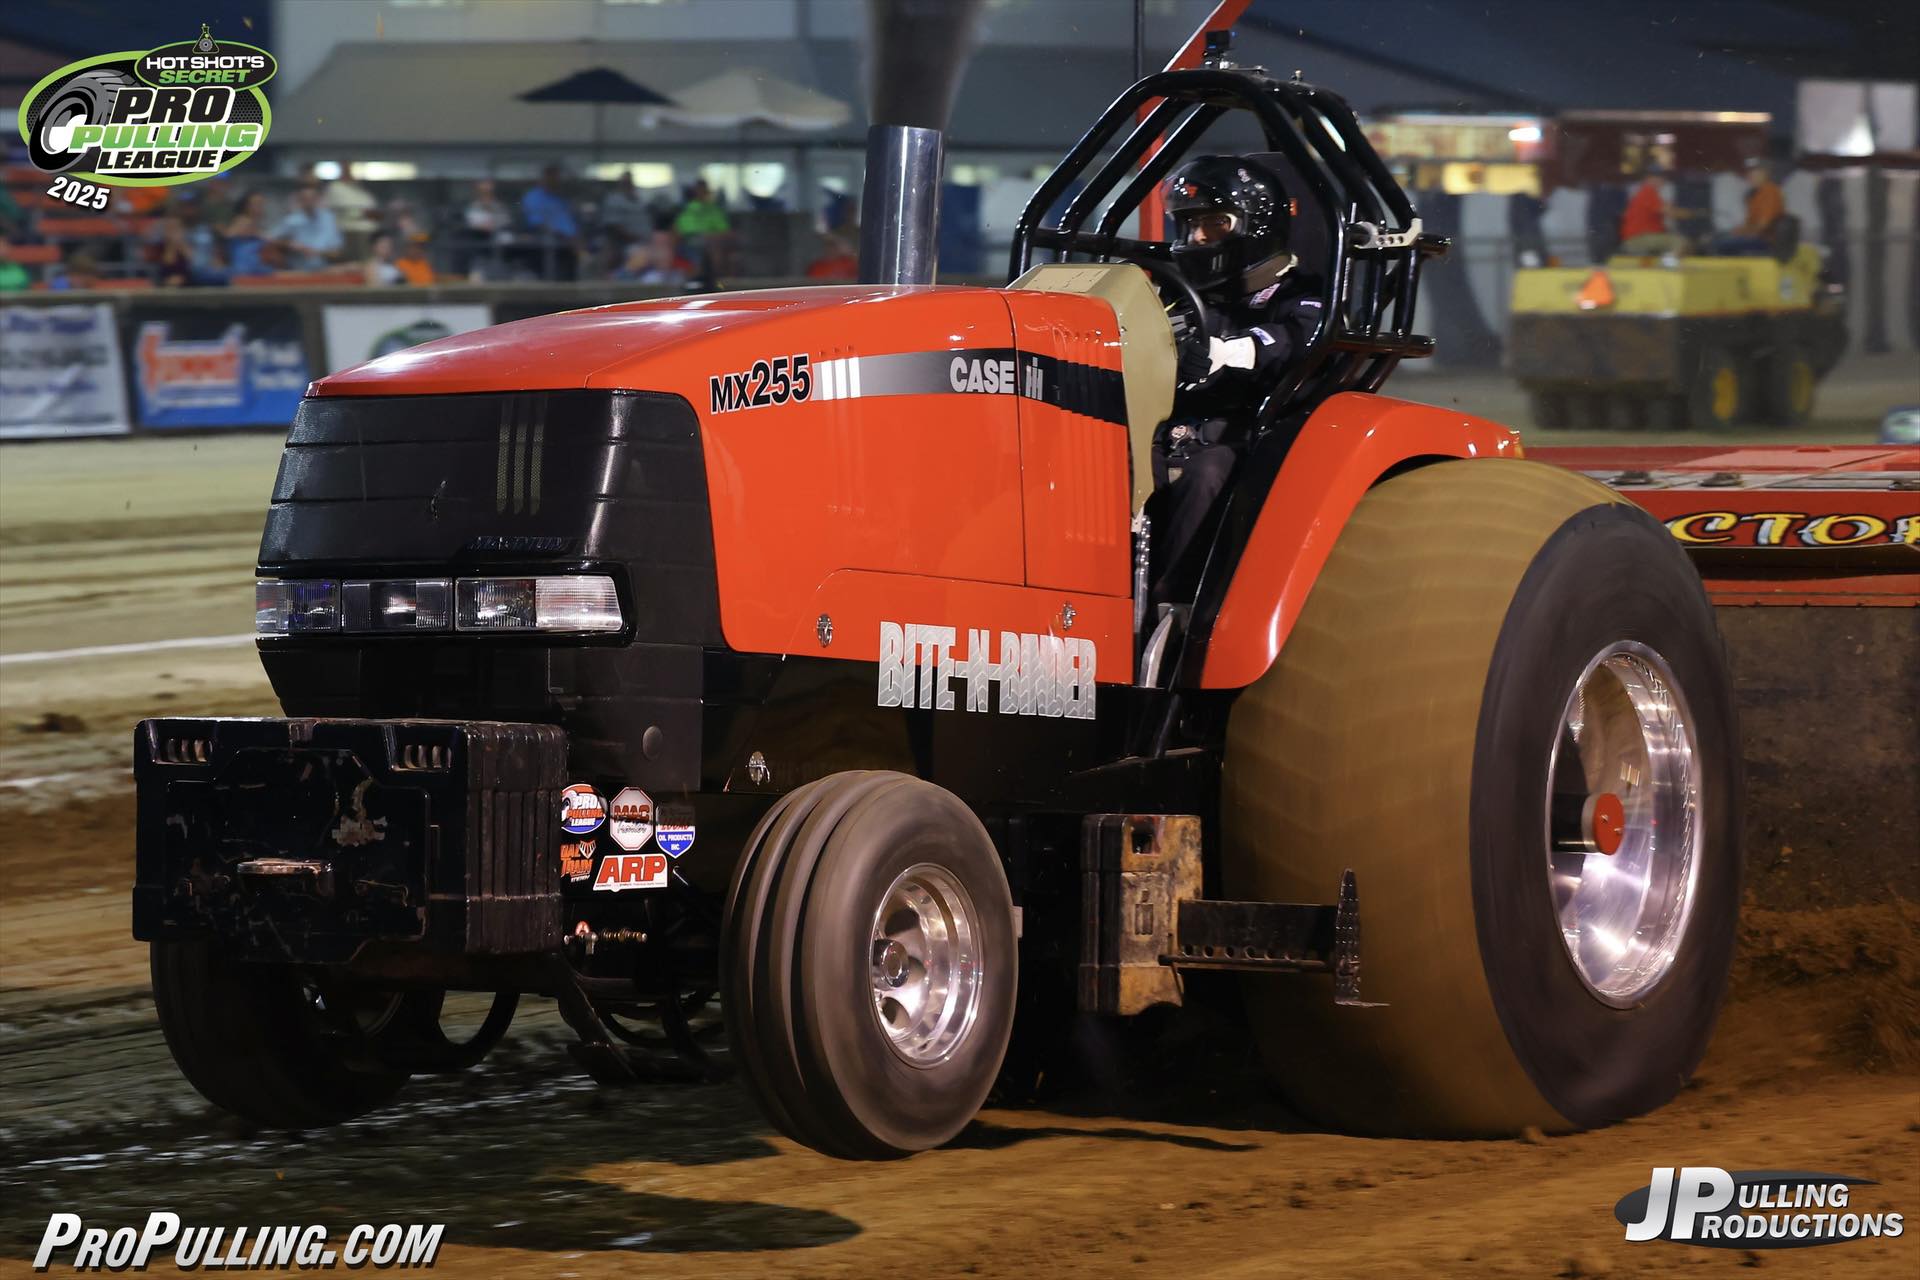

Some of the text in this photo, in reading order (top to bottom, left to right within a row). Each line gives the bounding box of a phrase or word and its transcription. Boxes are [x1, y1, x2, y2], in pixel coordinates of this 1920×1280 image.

[709, 352, 812, 415] MX255
[949, 356, 1015, 394] CASE
[596, 855, 666, 884] ARP
